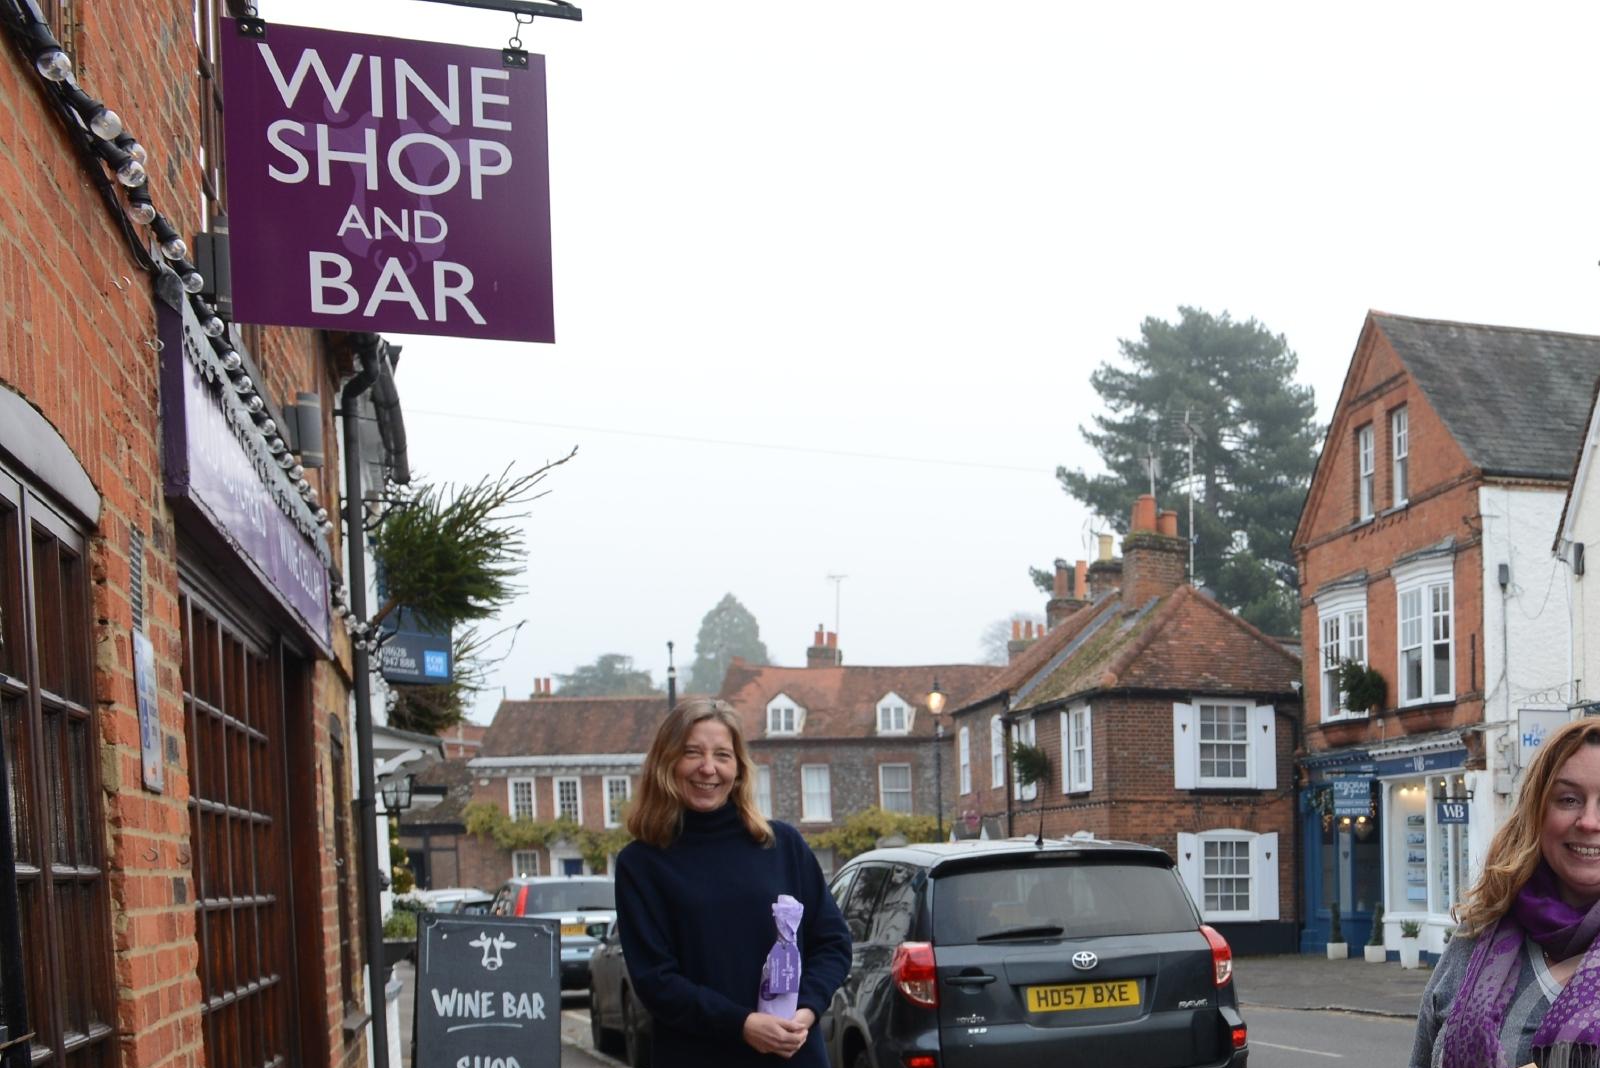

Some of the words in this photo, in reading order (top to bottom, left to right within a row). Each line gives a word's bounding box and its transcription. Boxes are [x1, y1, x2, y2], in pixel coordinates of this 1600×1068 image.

[257, 42, 512, 131] WINE
[266, 119, 513, 200] SHOP
[337, 204, 448, 244] AND
[309, 250, 487, 325] BAR
[1442, 804, 1465, 818] WB
[431, 987, 496, 1018] WINE
[502, 991, 546, 1020] BAR
[1036, 986, 1086, 1008] HD57
[1093, 983, 1130, 1003] BXE
